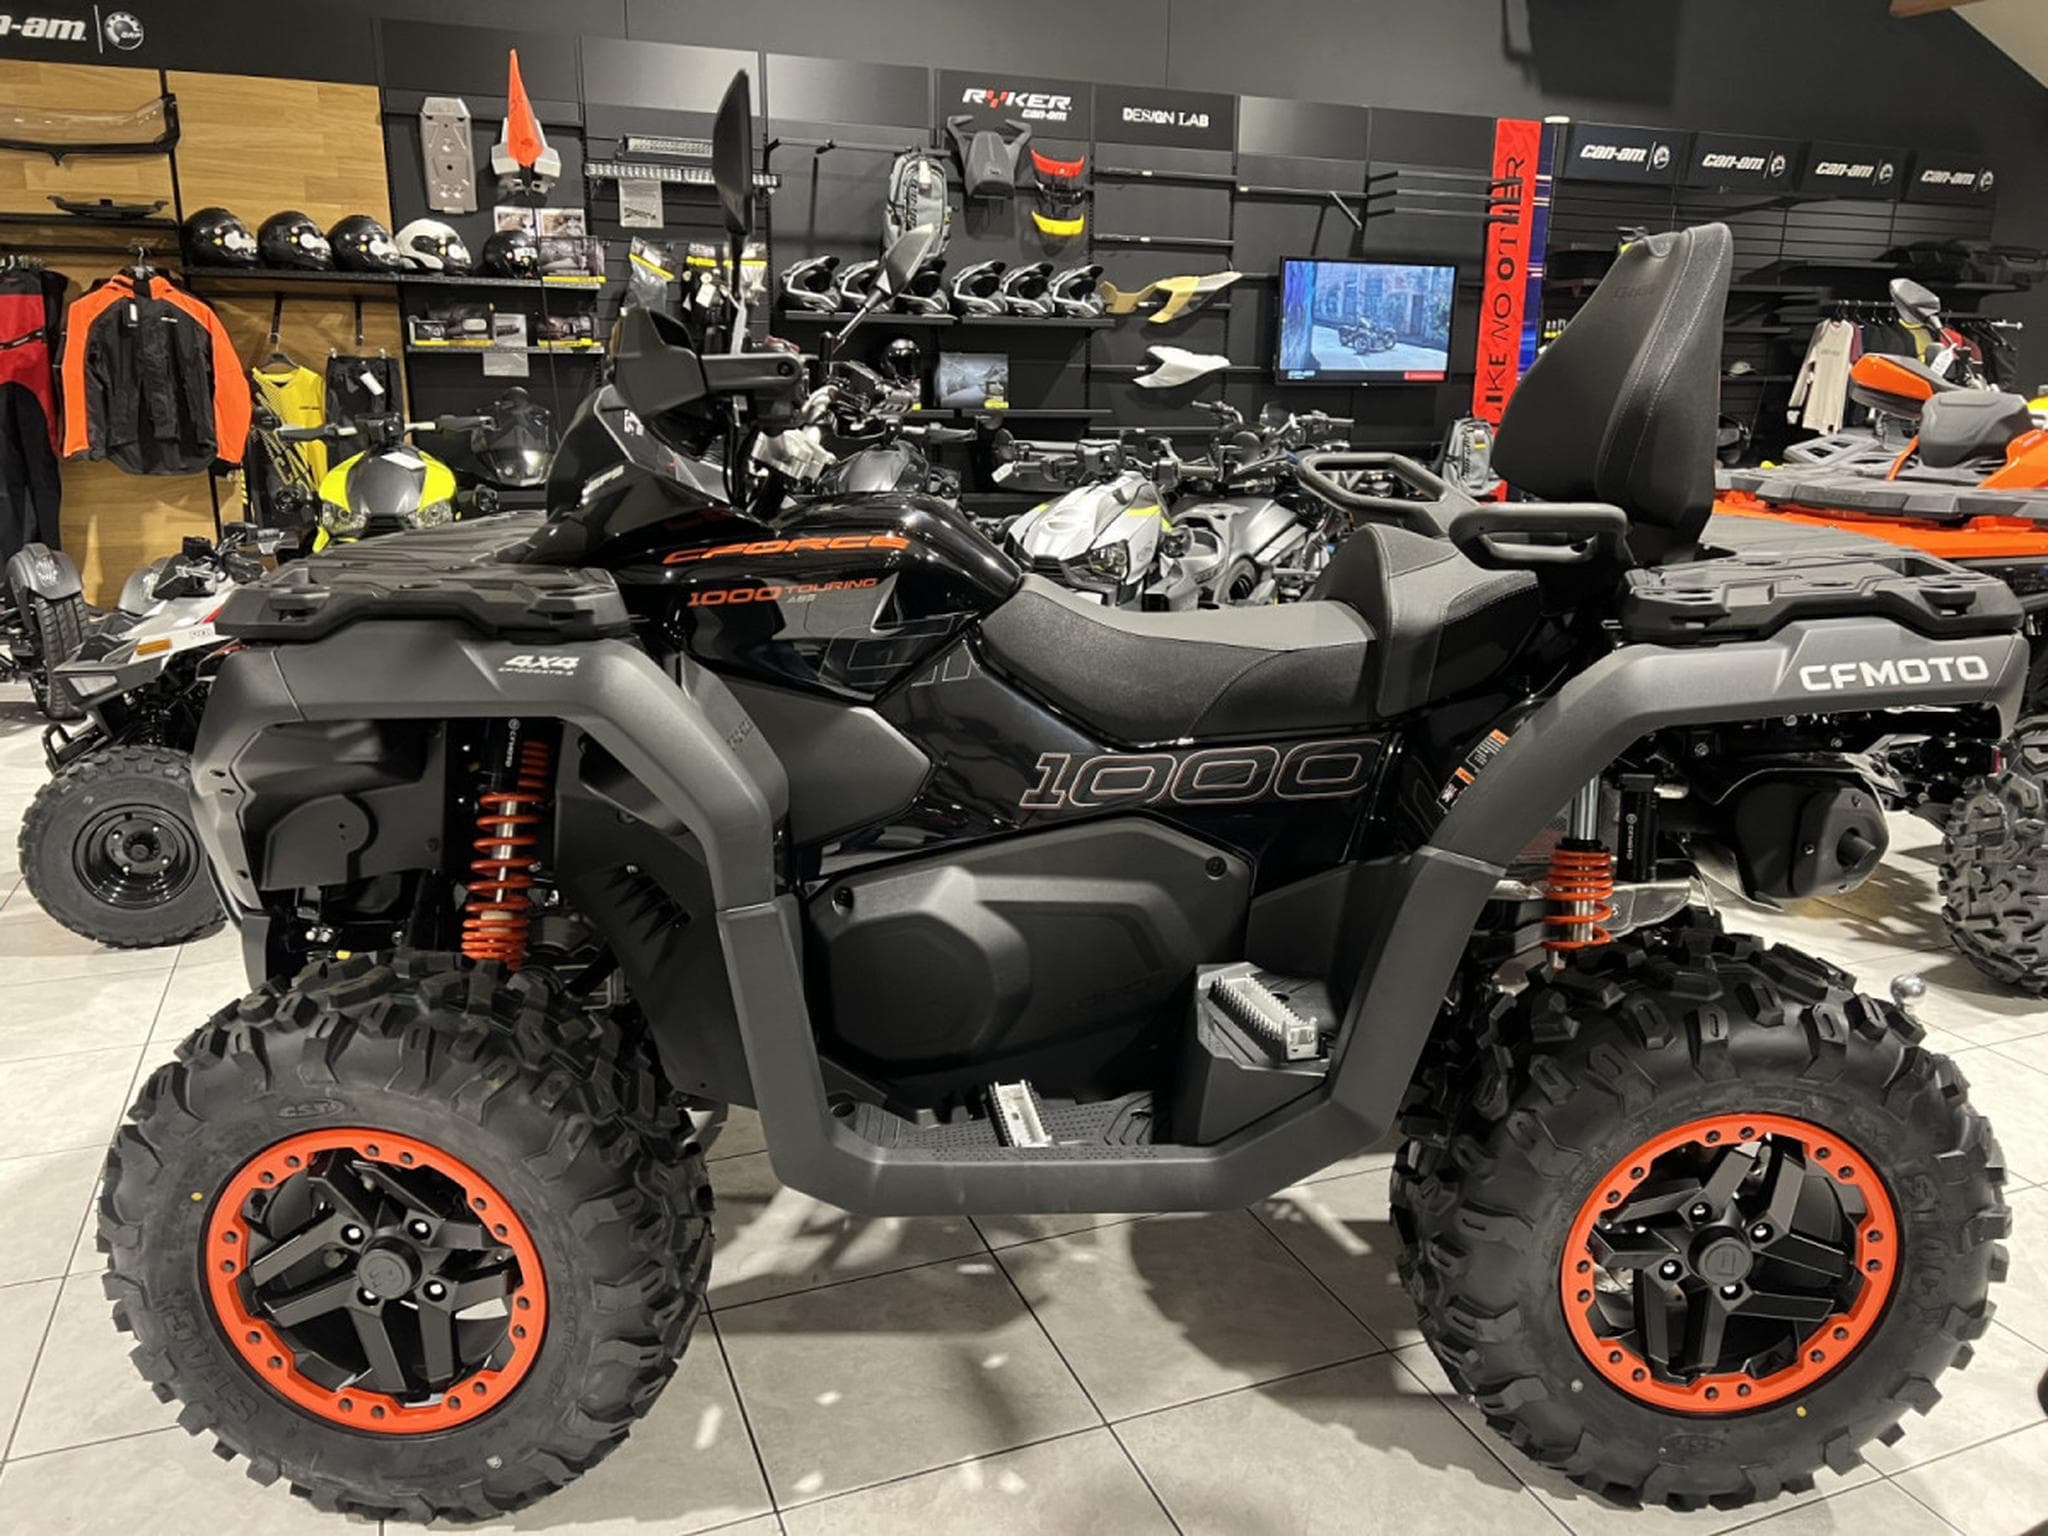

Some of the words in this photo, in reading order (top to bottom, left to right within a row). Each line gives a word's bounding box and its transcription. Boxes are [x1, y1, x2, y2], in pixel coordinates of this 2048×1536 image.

[962, 88, 1072, 111] RYKER
[1122, 107, 1175, 124] DESIGN
[1178, 112, 1209, 127] LAB
[1580, 144, 1647, 162] can-am
[1702, 153, 1766, 170] can-am
[1815, 161, 1875, 178] can-am
[1920, 169, 1975, 186] can-am
[1491, 293, 1512, 341] NO
[1485, 352, 1508, 412] IKE
[662, 535, 910, 565] CFORCE
[687, 584, 782, 607] 1000
[785, 577, 879, 595] TOURING
[1800, 655, 1990, 692] CFMOTO
[1019, 738, 1384, 811] 1000
